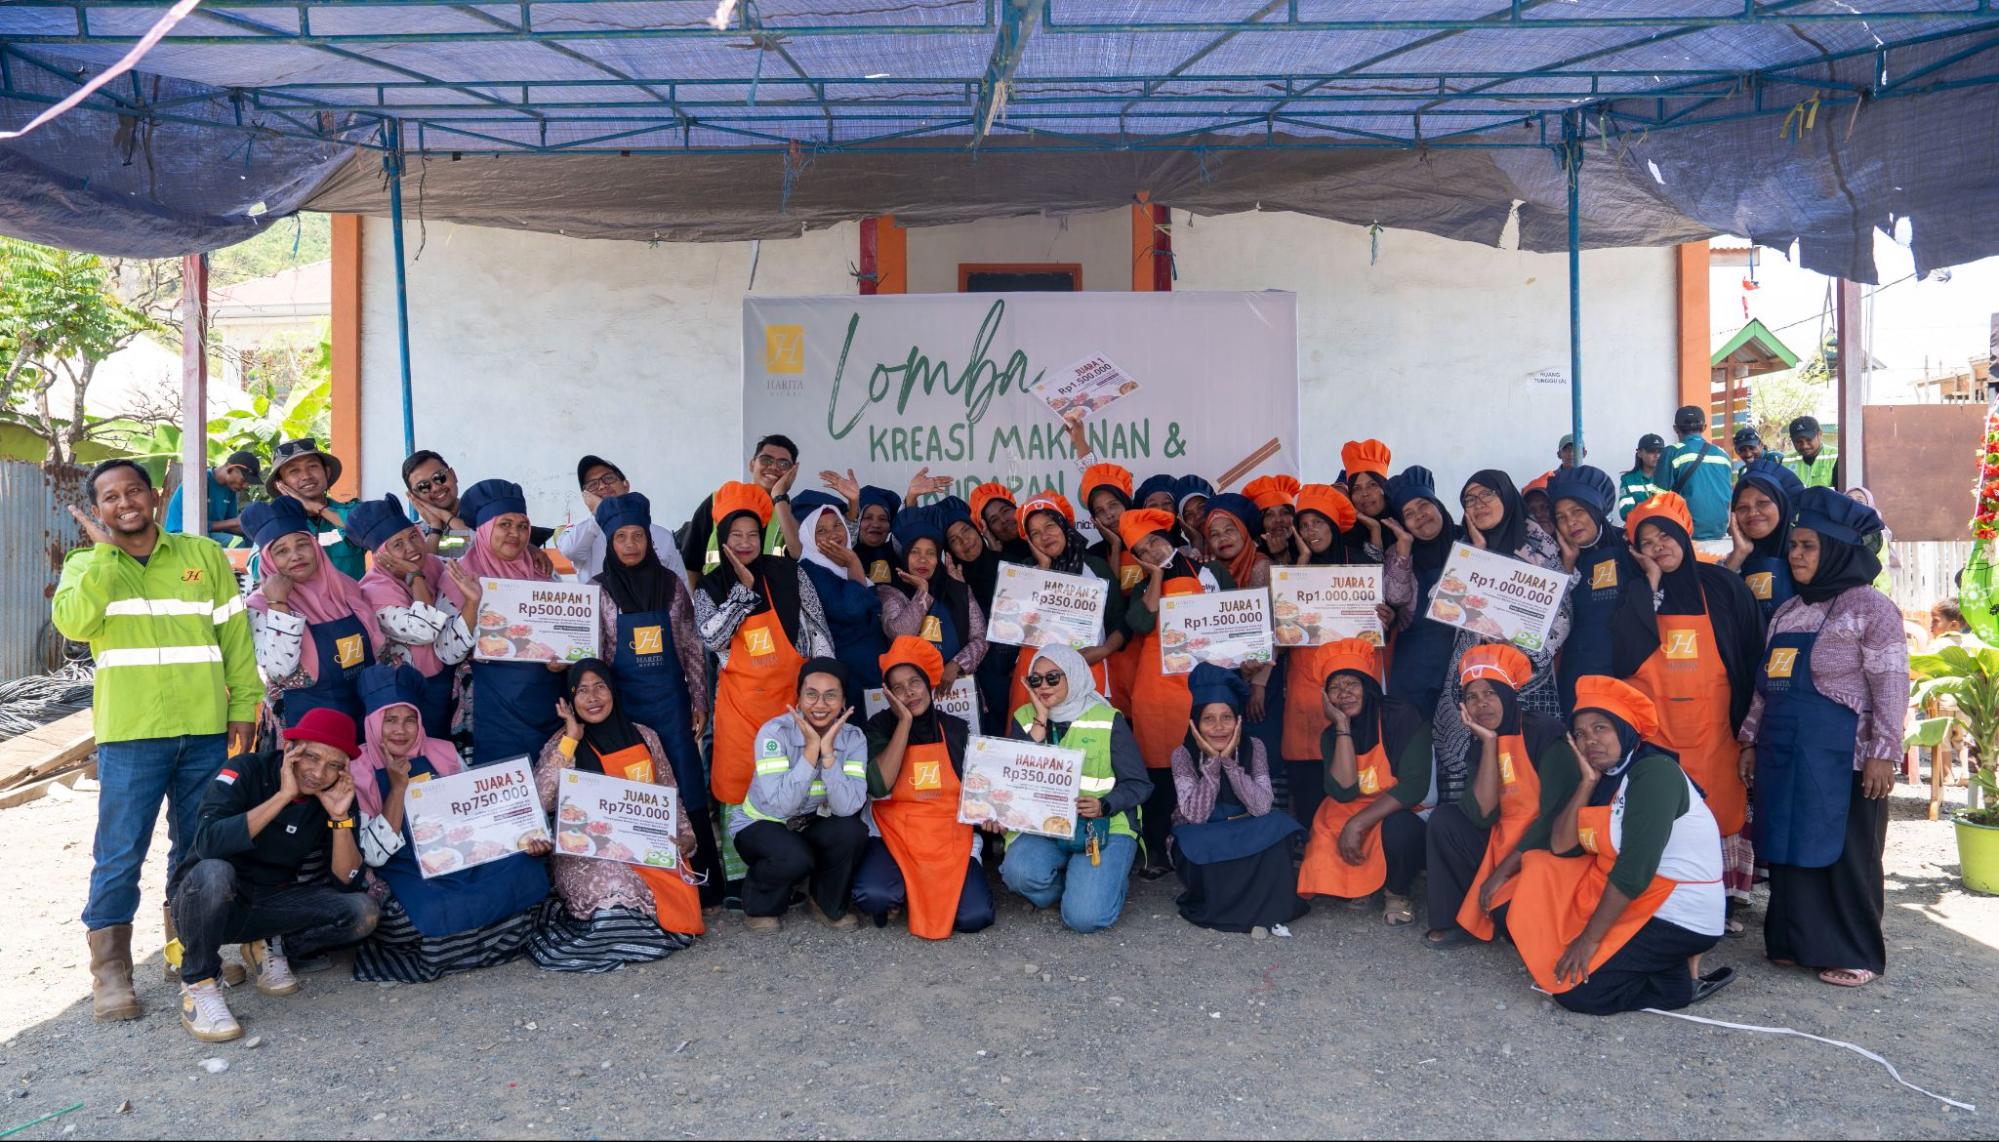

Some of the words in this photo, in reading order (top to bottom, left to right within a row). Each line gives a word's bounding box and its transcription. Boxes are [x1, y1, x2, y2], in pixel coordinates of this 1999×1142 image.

[828, 298, 1047, 440] Lomba
[1074, 360, 1100, 377] JUARA
[1057, 363, 1112, 395] Rp1.500.000
[869, 422, 975, 463] KREASI
[988, 418, 1151, 463] MAKNAN
[1163, 421, 1187, 459] &
[1044, 580, 1089, 598] HARAPAN
[1091, 588, 1099, 599] 2
[1331, 576, 1365, 589] JUARA
[1368, 577, 1375, 588] 2
[1469, 571, 1553, 606] Rp1.000.000
[1509, 570, 1547, 591] JUARA
[1550, 582, 1558, 594] 2
[532, 590, 583, 605] HARAPAN
[586, 594, 591, 605] 1
[1032, 591, 1097, 612] Rp350.000
[1219, 599, 1253, 613] JUARA
[1256, 598, 1261, 610] 1
[1297, 590, 1375, 604] Rp1.000.000
[519, 602, 592, 617] Rp500.000
[1184, 611, 1263, 631] Rp1.500.000
[1015, 753, 1064, 771] HARAPAN
[1066, 761, 1074, 772] 2
[474, 773, 513, 794] JUARA
[515, 770, 526, 783] 3
[1003, 766, 1072, 787] Rp350.000
[451, 785, 529, 815] Rp750.000
[623, 789, 658, 807] JUARA
[662, 795, 669, 807] 3
[599, 799, 670, 821] Rp750.000
